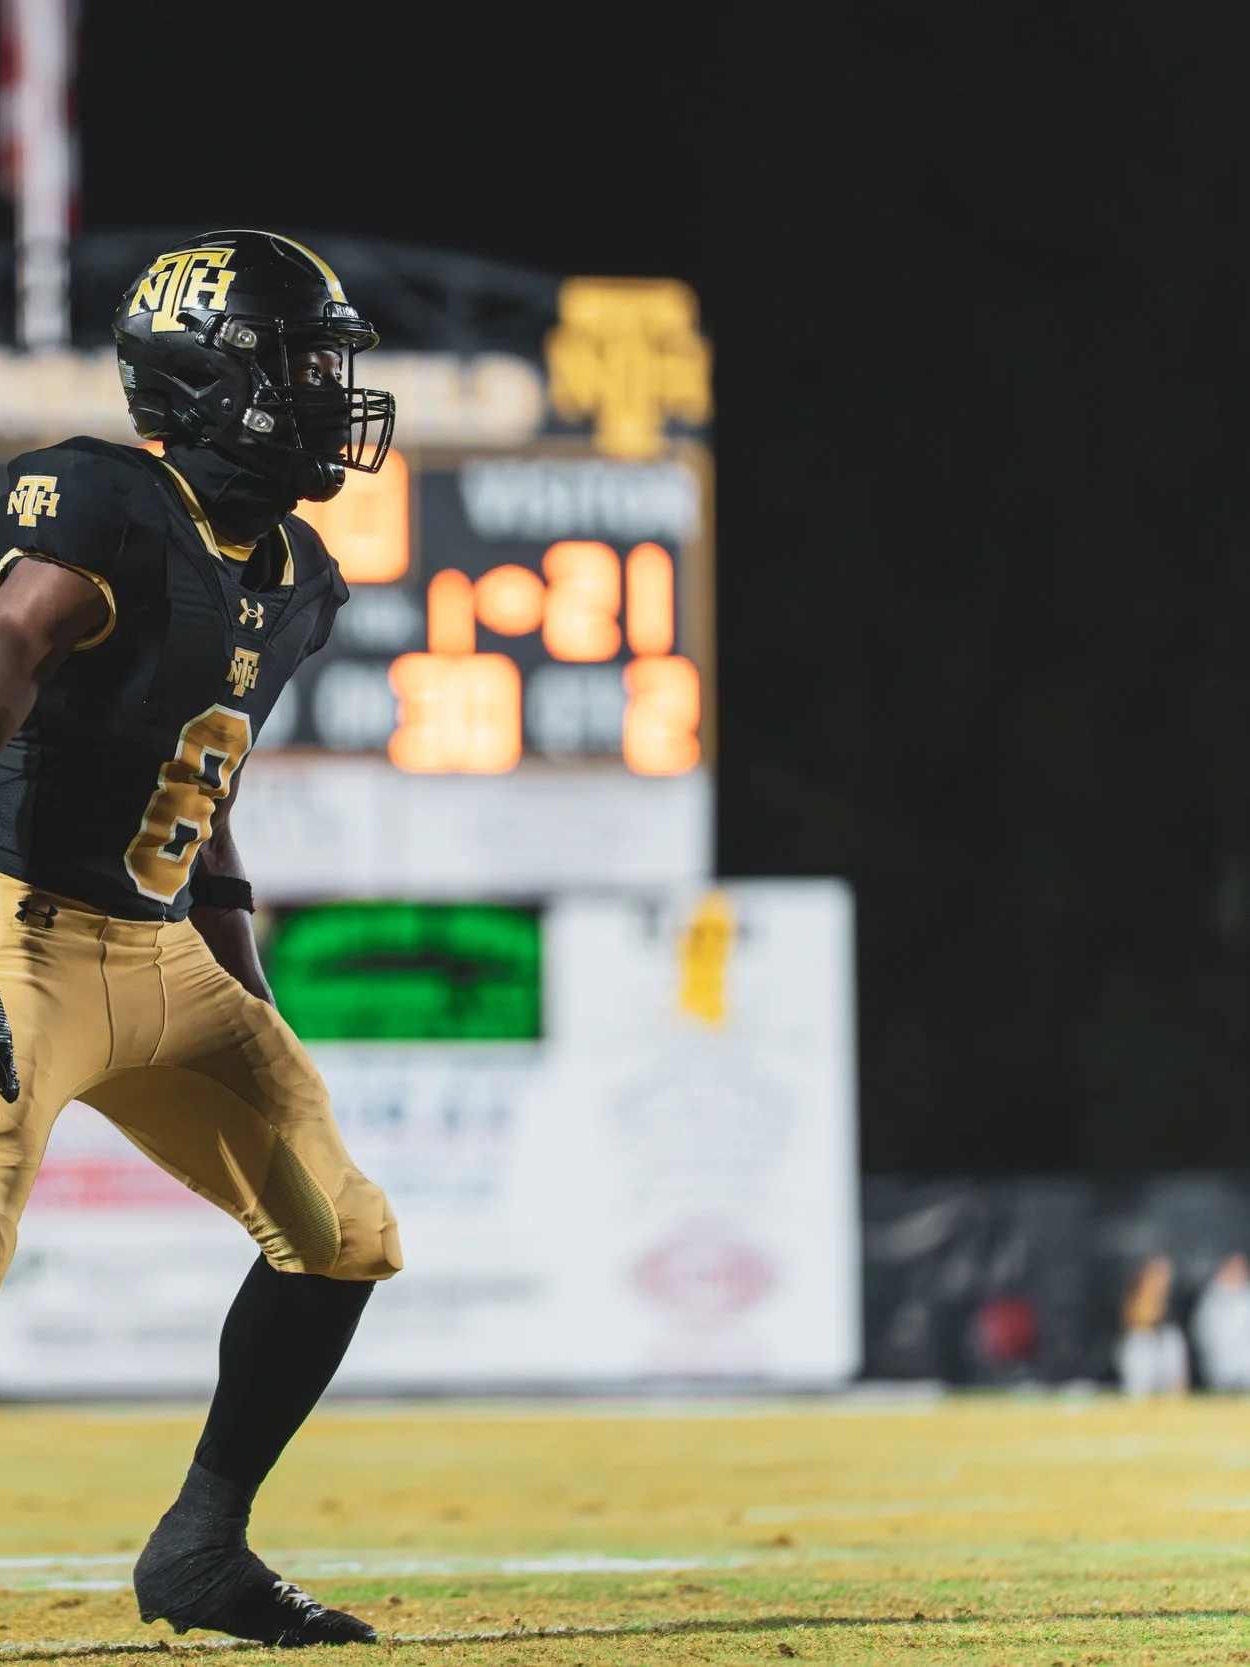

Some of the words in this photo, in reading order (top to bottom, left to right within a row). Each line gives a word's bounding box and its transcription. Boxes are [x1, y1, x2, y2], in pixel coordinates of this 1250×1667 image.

[129, 247, 236, 332] NTH
[7, 475, 60, 527] NTH
[226, 646, 260, 697] NTH
[124, 703, 252, 905] 8
